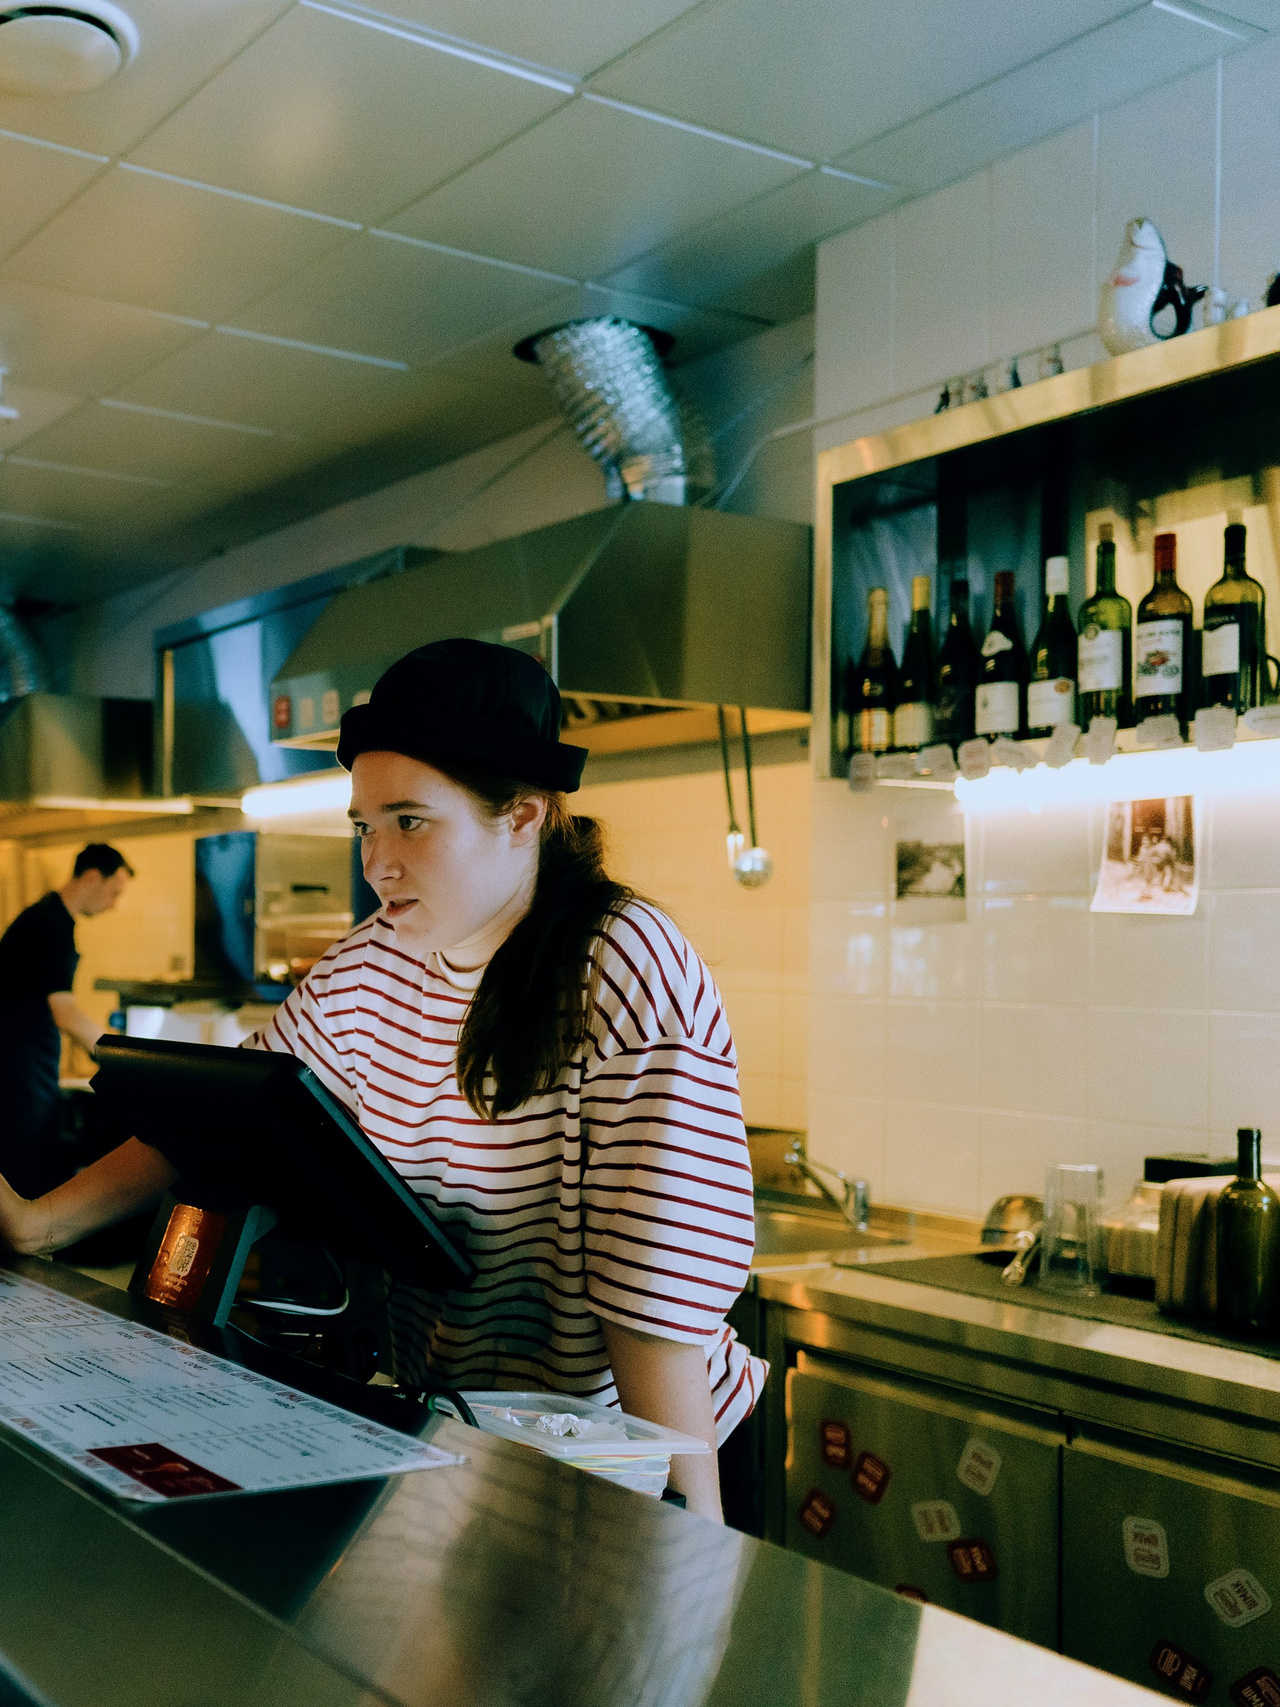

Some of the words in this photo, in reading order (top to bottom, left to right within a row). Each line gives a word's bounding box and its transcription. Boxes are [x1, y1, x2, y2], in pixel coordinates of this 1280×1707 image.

[1230, 1580, 1259, 1610] ШМАК
[1179, 1664, 1199, 1691] ШМАК
[1241, 1686, 1266, 1707] ШМА
